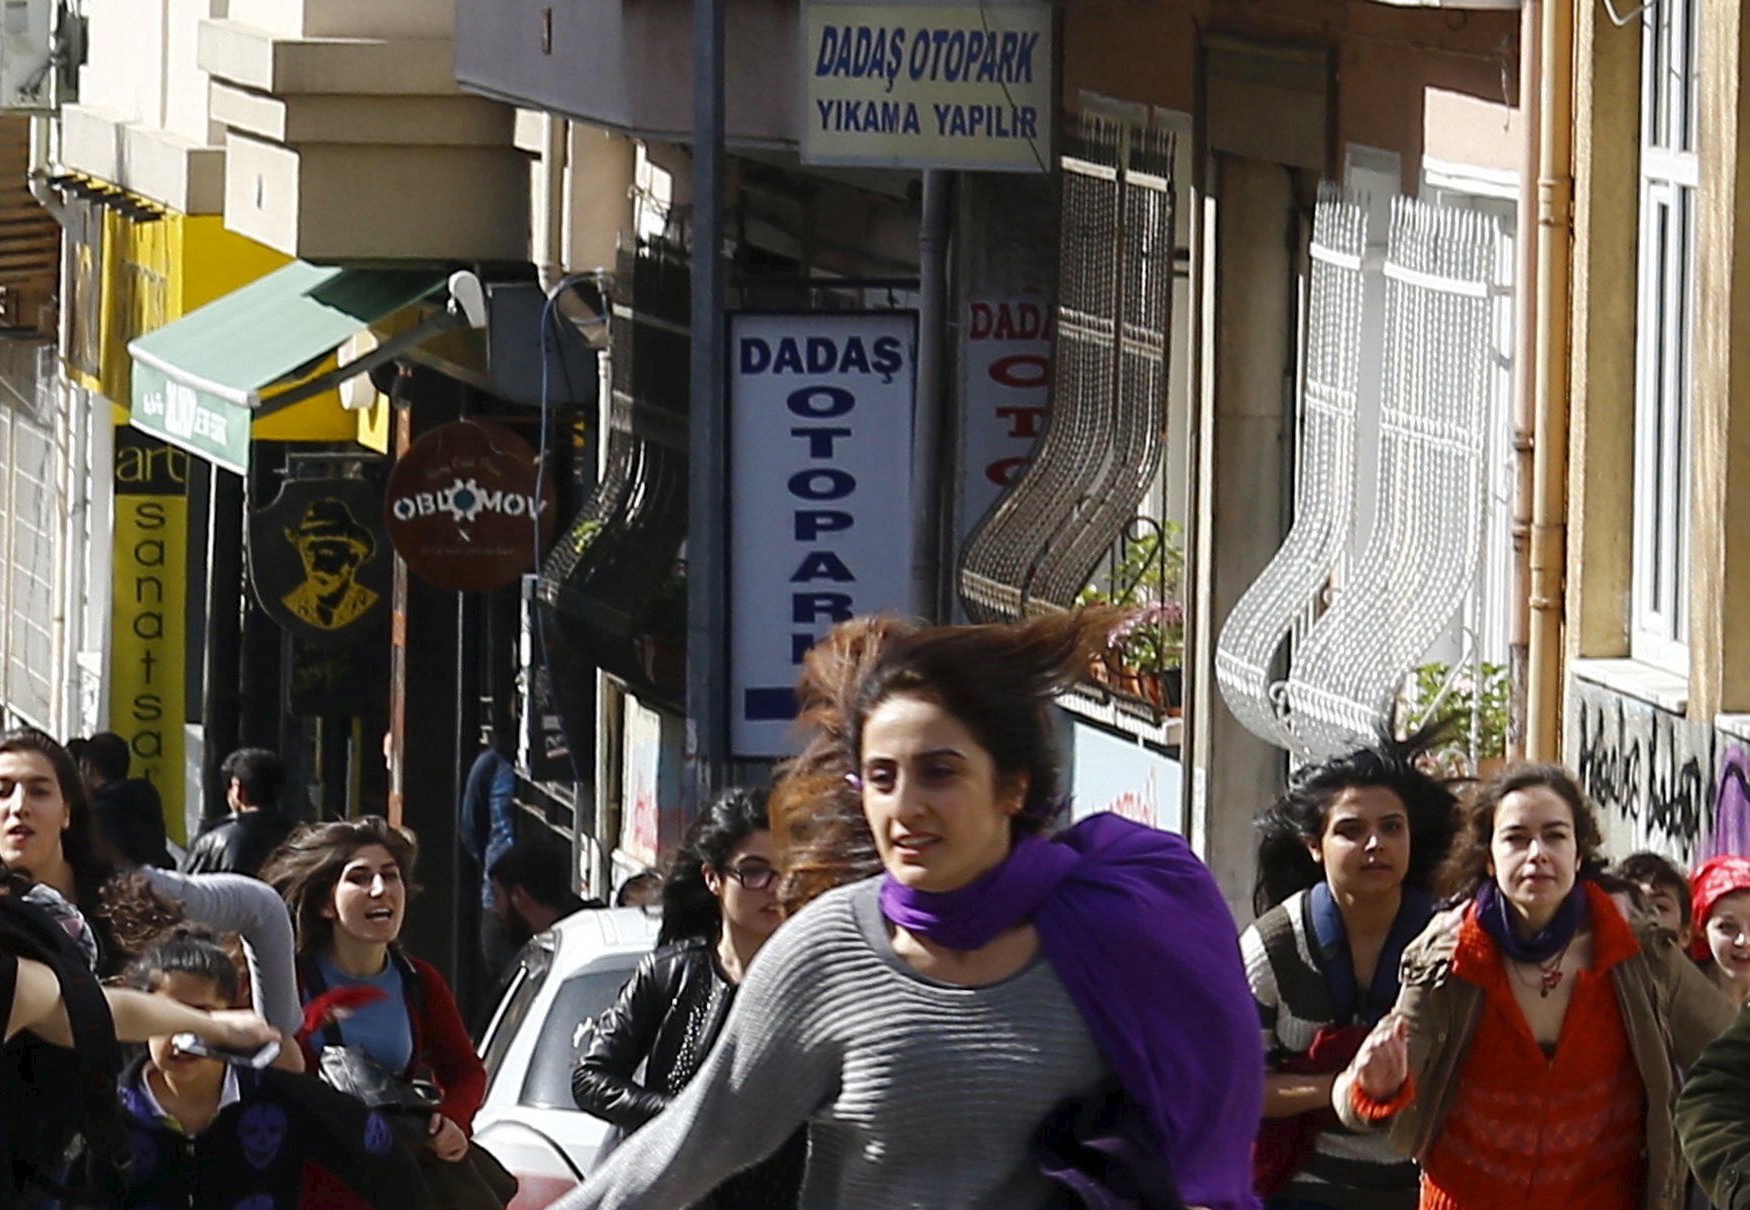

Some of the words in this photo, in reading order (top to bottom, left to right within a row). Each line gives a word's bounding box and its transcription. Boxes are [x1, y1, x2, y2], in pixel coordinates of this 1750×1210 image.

[815, 25, 906, 93] DADAŞ
[908, 28, 1040, 83] OTOPARK
[817, 99, 921, 135] YIKAMA
[933, 103, 1038, 138] YAPILIR
[970, 302, 1051, 340] DAD
[739, 336, 903, 384] DADAŞ
[393, 478, 548, 523] OBLOMOV
